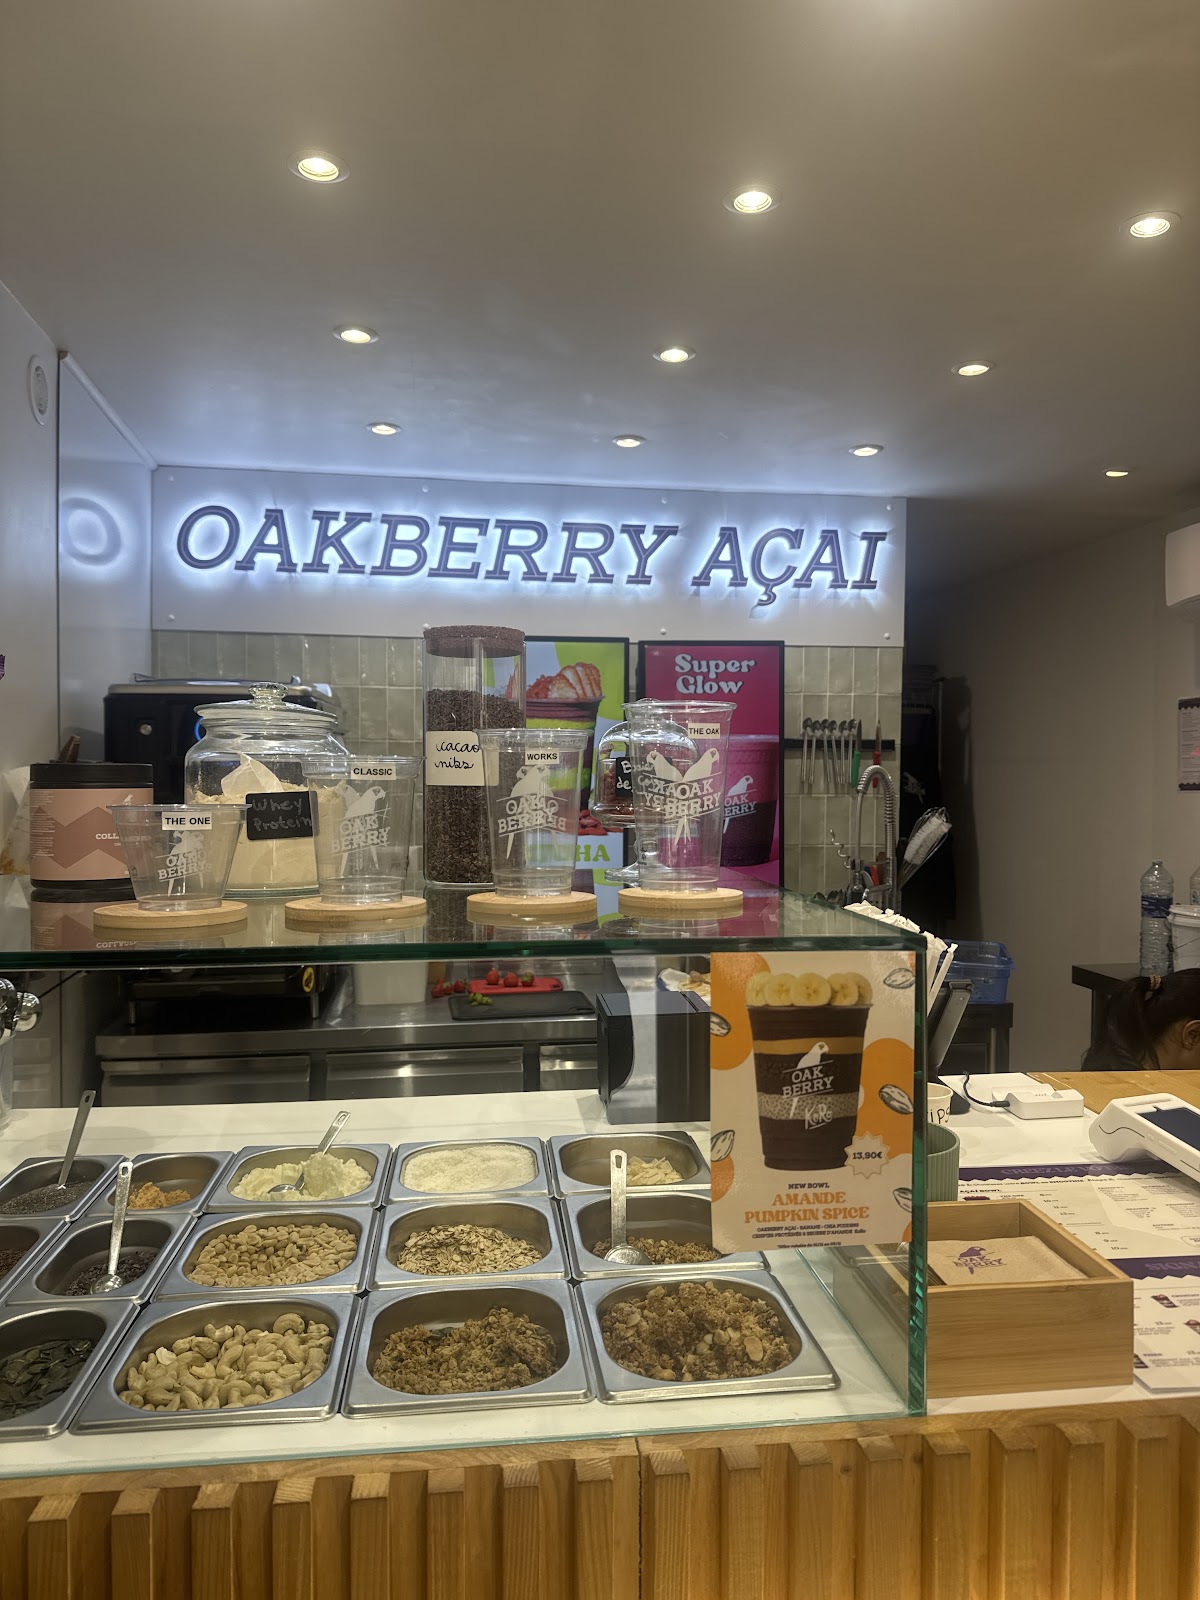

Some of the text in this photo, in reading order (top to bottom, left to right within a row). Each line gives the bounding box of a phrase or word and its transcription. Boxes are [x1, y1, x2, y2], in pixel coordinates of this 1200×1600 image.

[176, 505, 679, 585] OAKBERRY
[691, 526, 888, 606] AÇAI
[675, 653, 755, 679] Super
[676, 675, 743, 694] Glow
[689, 727, 720, 736] THE OAK
[436, 741, 480, 753] cacao
[434, 757, 475, 769] nibs
[526, 752, 558, 761] WORKS
[353, 767, 393, 776] CLASSIC
[616, 776, 632, 790] de
[676, 778, 714, 800] OAK
[252, 798, 302, 815] Whey
[664, 792, 722, 820] BERRY
[724, 793, 749, 806] OAK
[724, 801, 757, 815] ERRY
[165, 816, 211, 826] THE ONE
[253, 815, 312, 832] Protein
[340, 814, 379, 836] OAK
[330, 826, 391, 854] BERRY
[791, 1066, 824, 1083] OAK
[782, 1076, 834, 1098] BERRY
[852, 1151, 883, 1160] 13,90€
[772, 1191, 847, 1206] AMANDE
[744, 1206, 870, 1224] PUMPKIN SPICE
